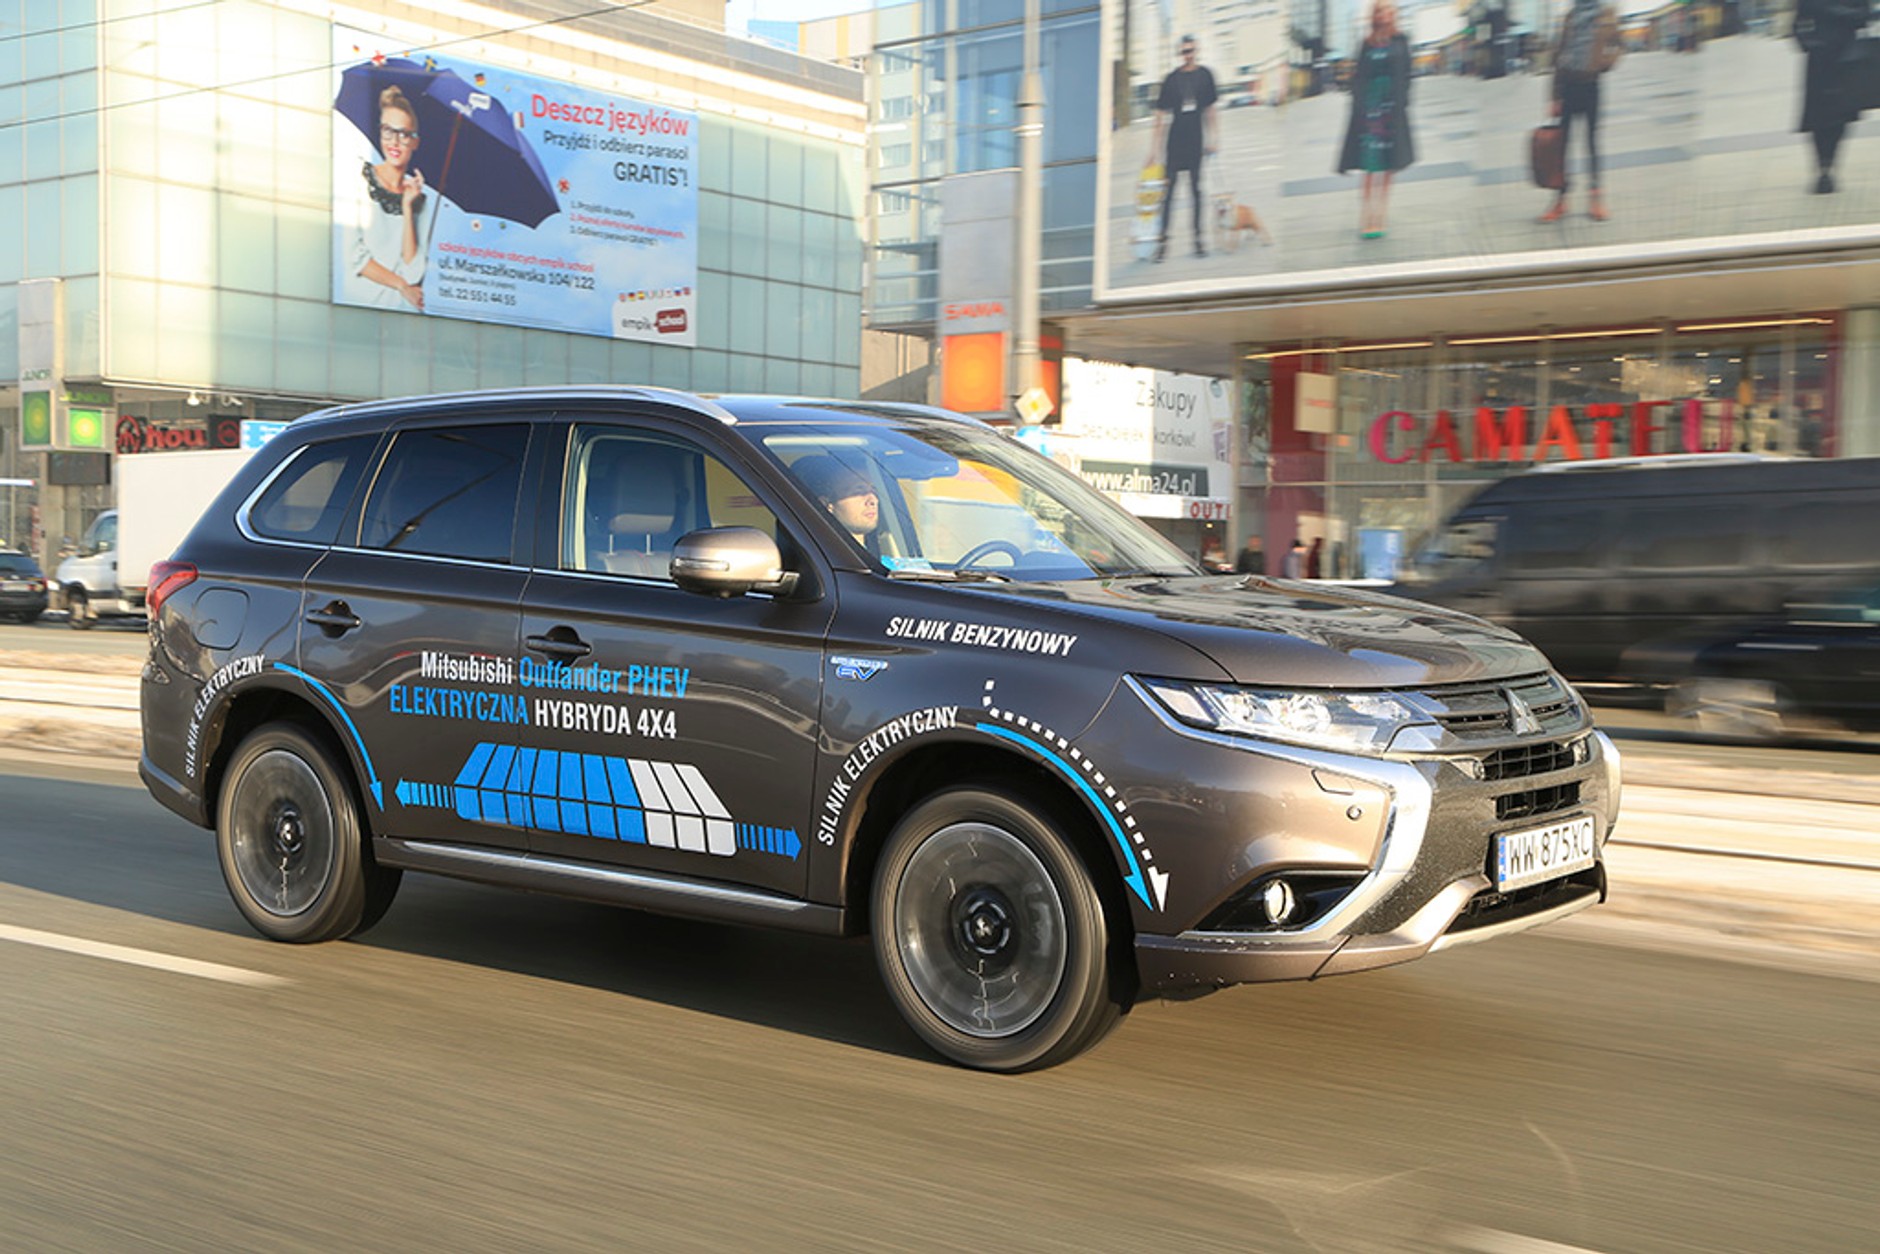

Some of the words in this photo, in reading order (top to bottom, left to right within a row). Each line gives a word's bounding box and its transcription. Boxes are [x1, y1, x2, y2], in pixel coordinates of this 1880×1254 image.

[531, 93, 605, 126] Deszcz
[607, 102, 690, 136] języków
[600, 136, 645, 156] odbierz
[646, 145, 690, 161] parasol
[454, 257, 546, 284] Marszałkowska
[548, 271, 596, 290] 104/122
[1136, 379, 1197, 420] Zakupy
[1081, 467, 1197, 497] www.alma24.pl
[885, 616, 950, 642] SILNIK
[950, 623, 1078, 657] BENZYNOWY
[420, 650, 514, 685] Mitsubishi
[518, 656, 621, 694] Outlander
[627, 664, 690, 699] PHEV
[184, 717, 200, 778] SILNIK
[194, 654, 265, 720] ELEKTRYCZNY
[389, 684, 530, 726] ELEKTRYCZNA
[533, 698, 633, 736] HYBRYDA
[635, 708, 678, 739] 4X4
[817, 774, 852, 847] SILNIK
[842, 705, 959, 782] ELEKTRYCZNY
[1509, 834, 1535, 875] WW
[1540, 821, 1592, 867] 875XC
